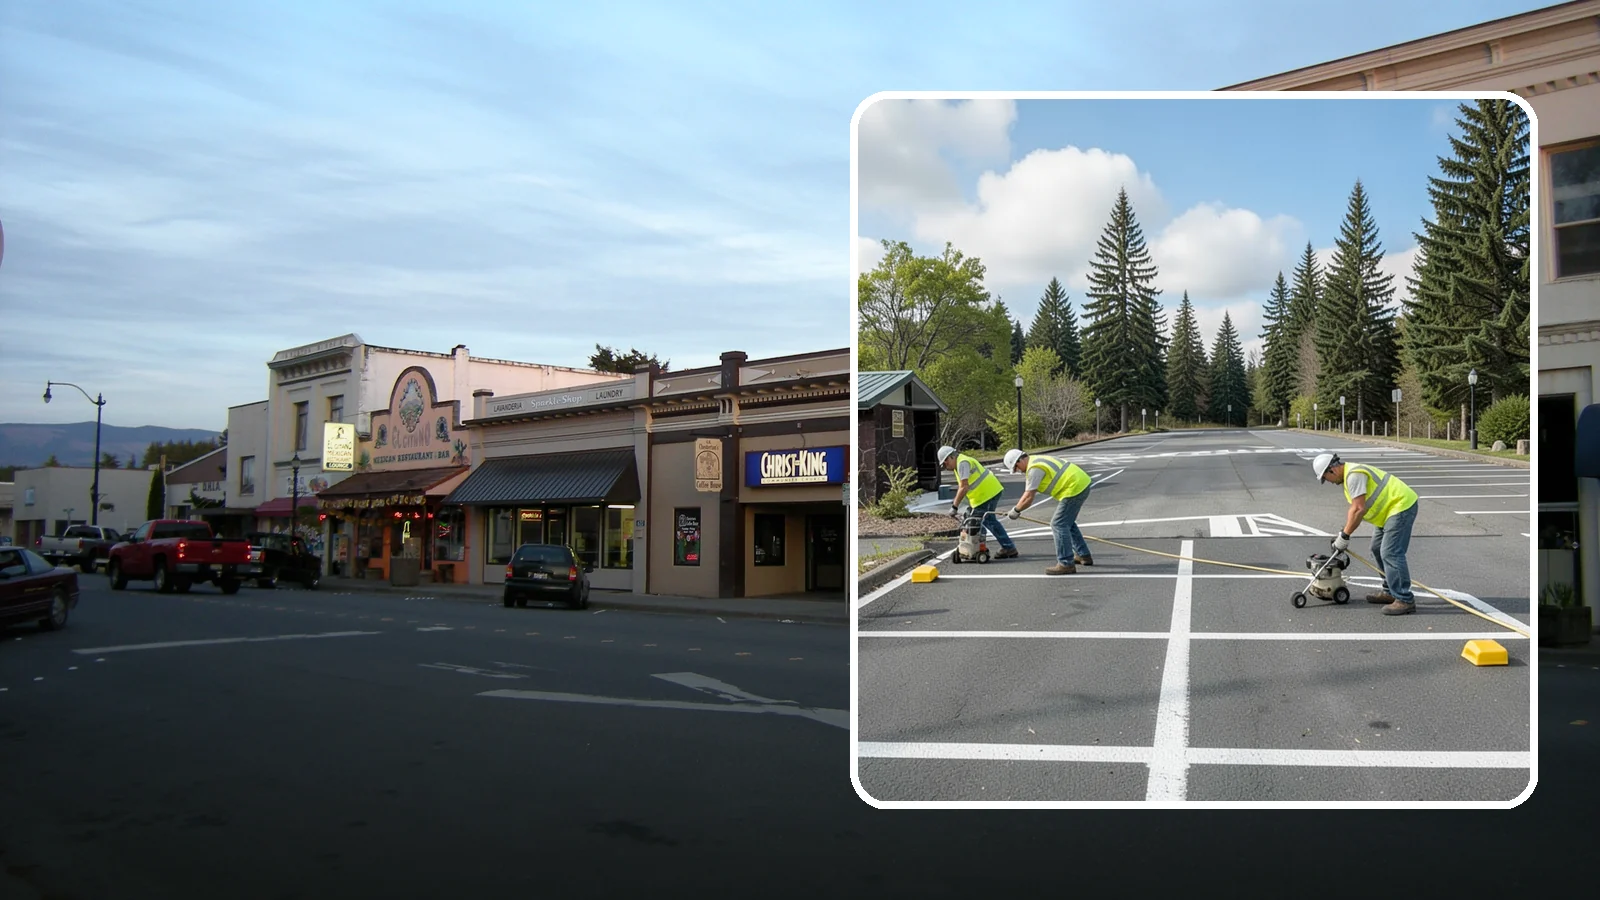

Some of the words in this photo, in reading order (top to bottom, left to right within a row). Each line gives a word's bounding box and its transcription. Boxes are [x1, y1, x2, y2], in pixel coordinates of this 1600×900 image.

[562, 394, 582, 404] Shop
[595, 389, 623, 399] LAUNDRY
[494, 402, 522, 412] LAVANDERIA
[374, 454, 396, 464] MEXICAN
[397, 451, 433, 462] RESTAURANT
[437, 450, 450, 459] BAR
[761, 452, 797, 478] CHRIST
[799, 449, 827, 476] KING
[696, 480, 709, 489] Coffee
